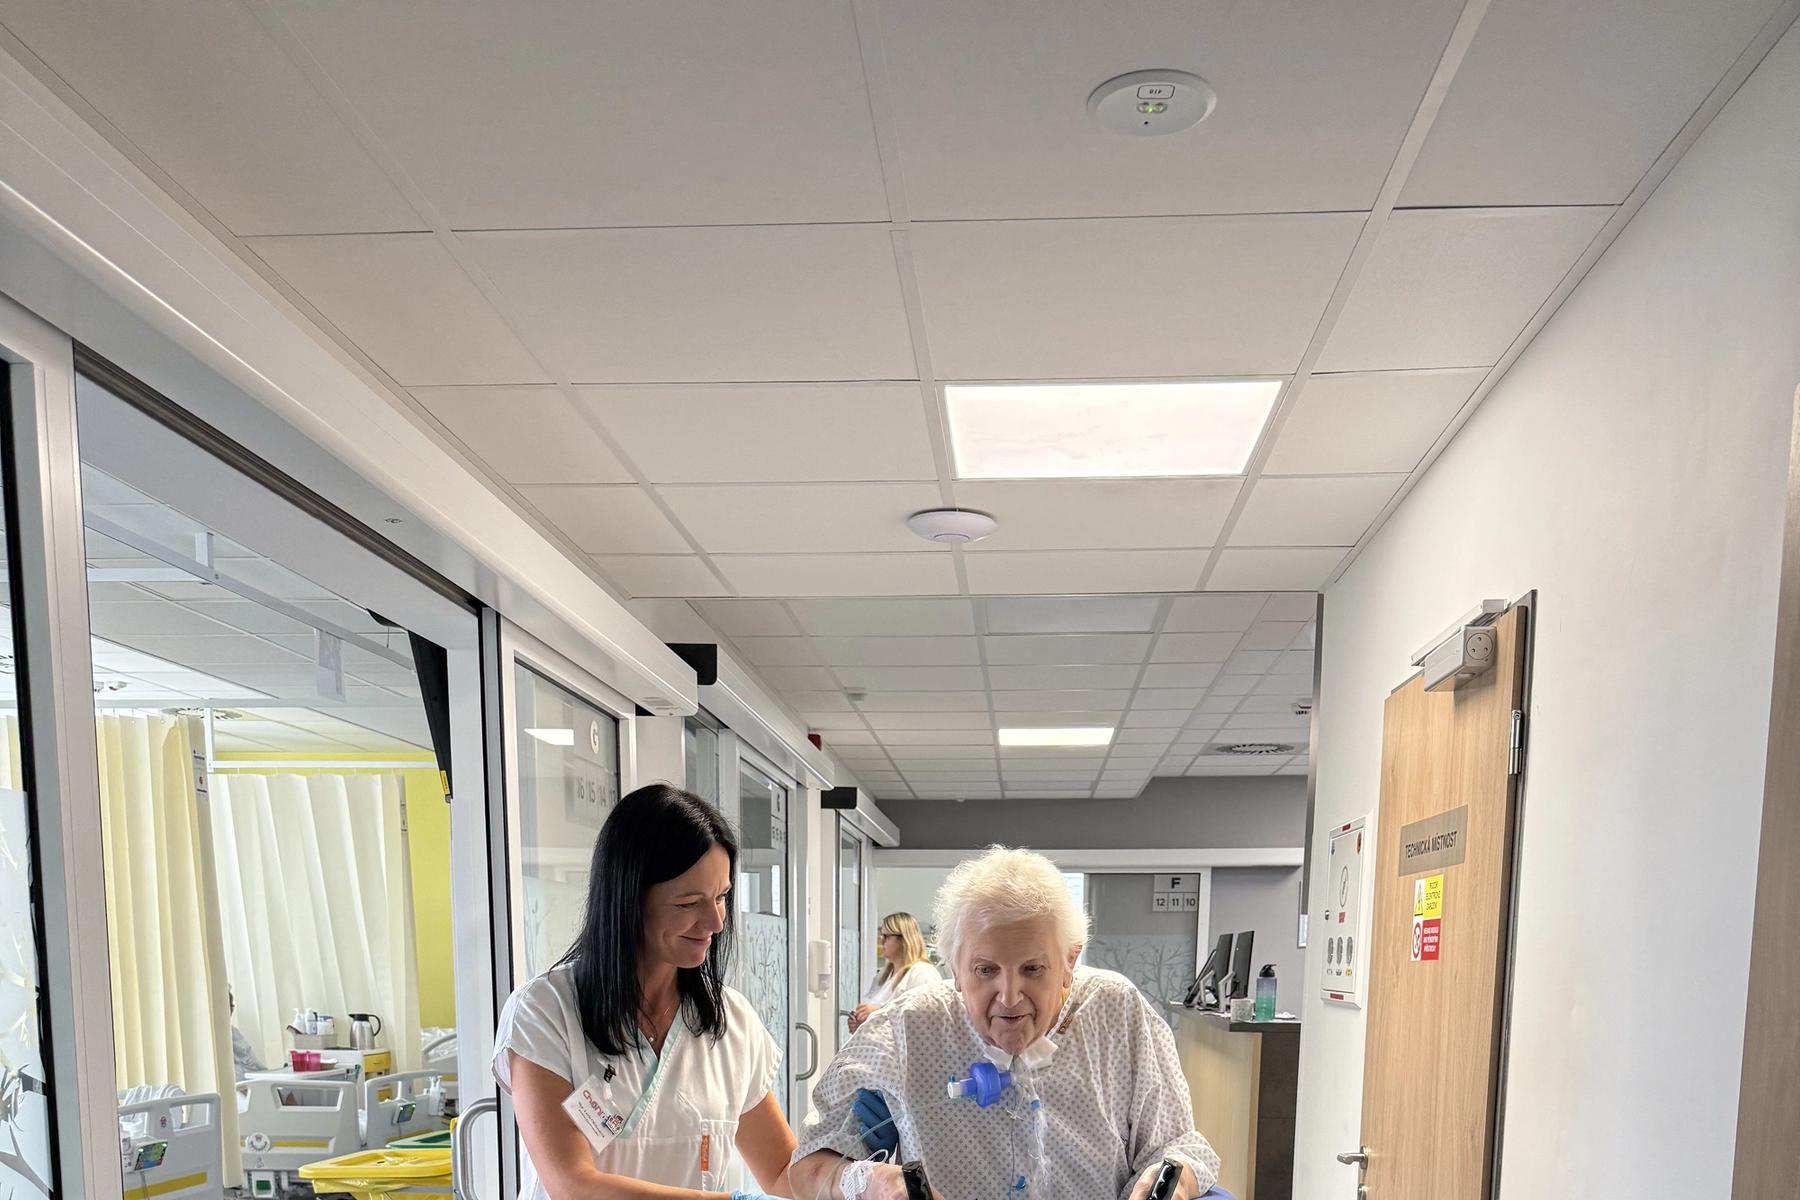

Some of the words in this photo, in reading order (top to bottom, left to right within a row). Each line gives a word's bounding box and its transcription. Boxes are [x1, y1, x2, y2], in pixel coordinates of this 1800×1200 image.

[1171, 877, 1181, 889] F
[1156, 898, 1166, 907] 12
[1172, 898, 1179, 907] 11
[1186, 897, 1196, 906] 10
